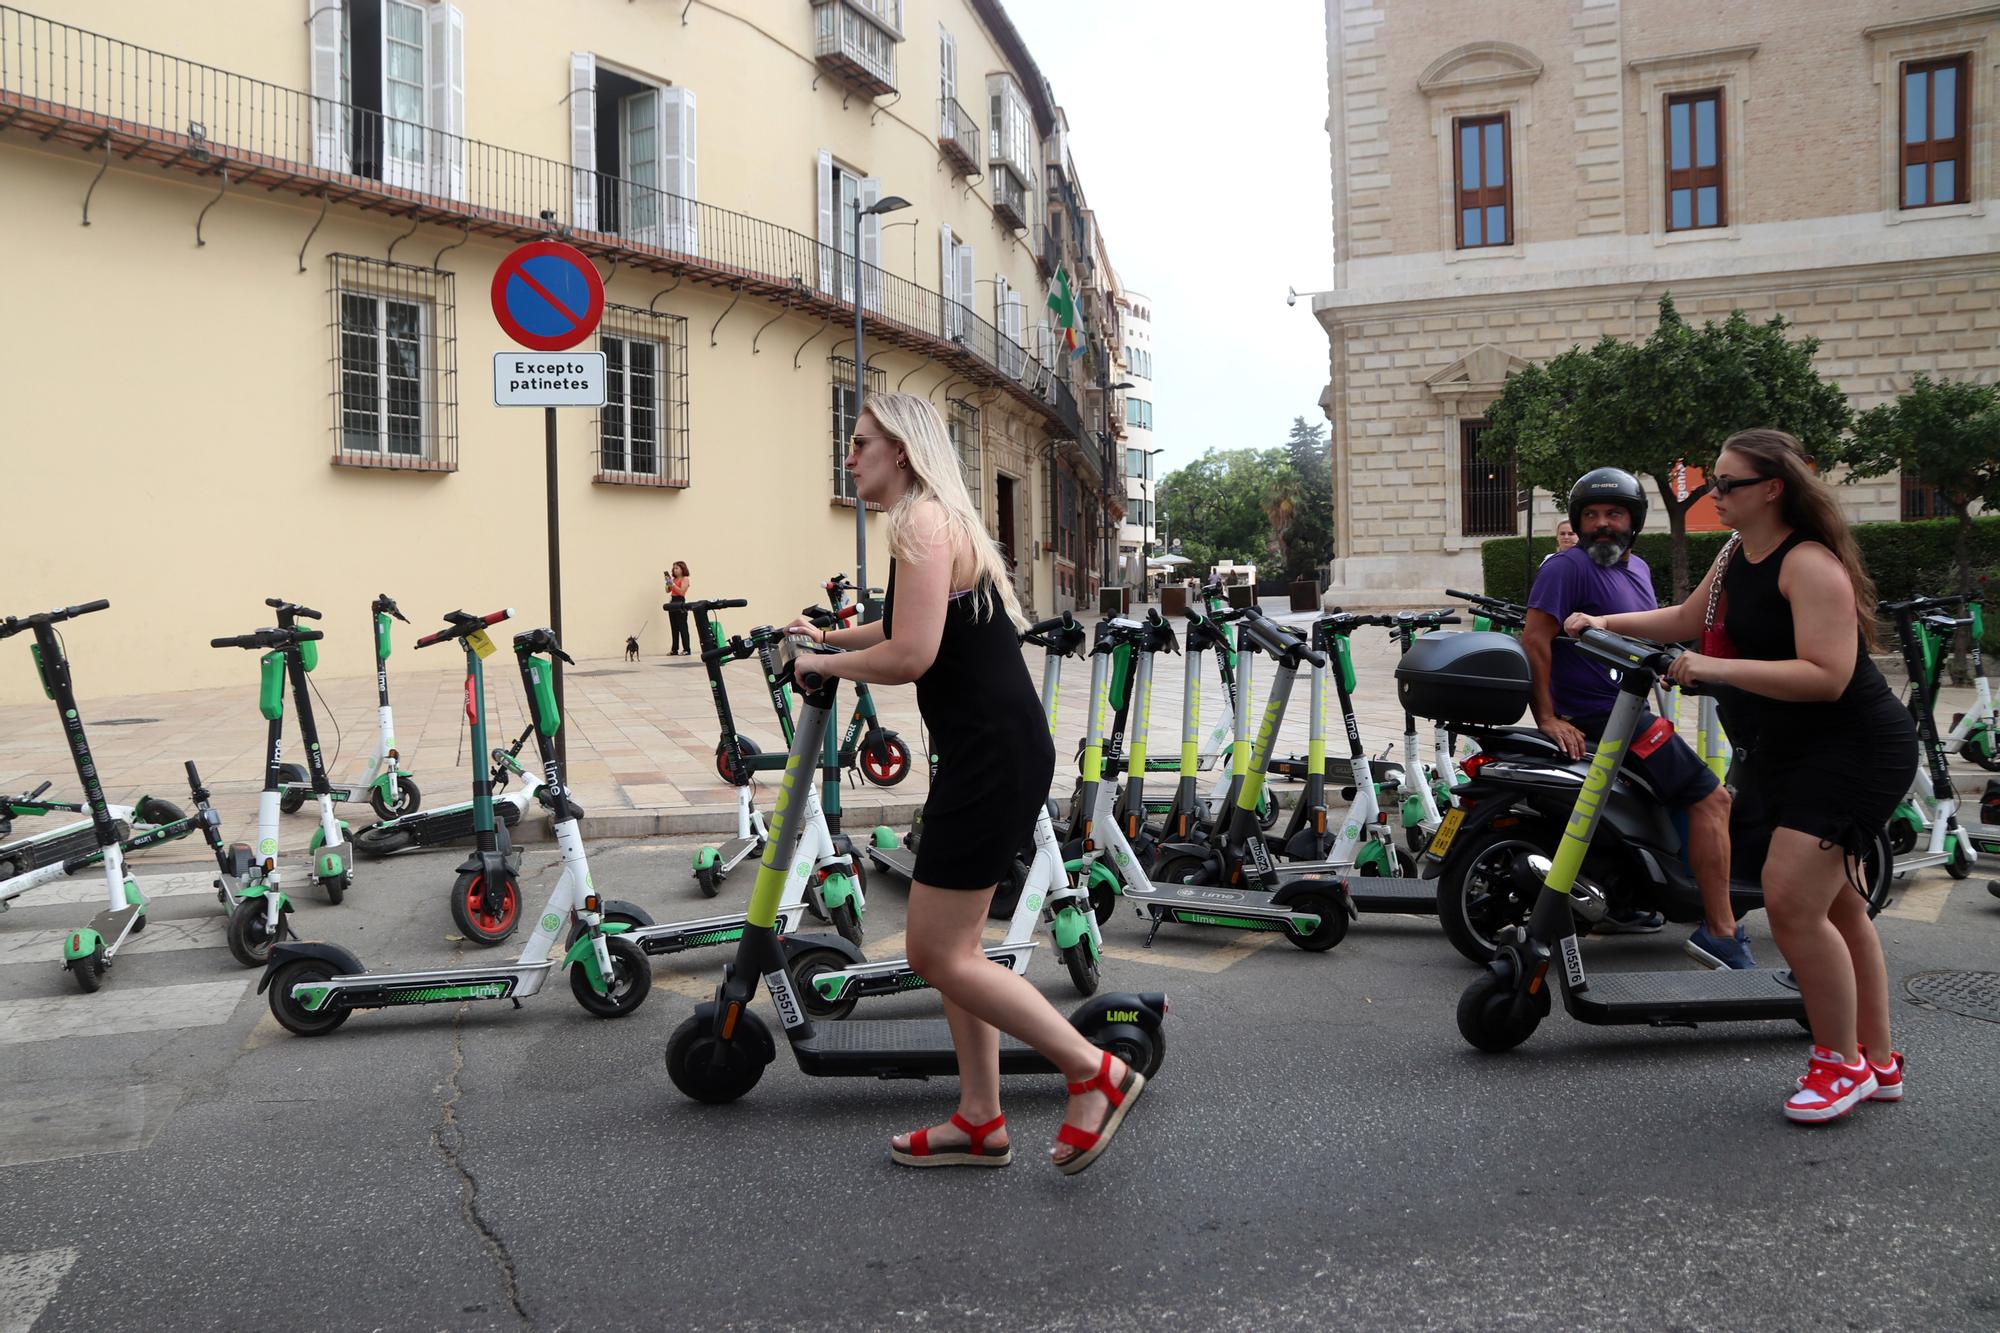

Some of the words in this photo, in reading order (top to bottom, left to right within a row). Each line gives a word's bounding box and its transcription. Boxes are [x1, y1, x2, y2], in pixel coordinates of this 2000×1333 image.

[515, 362, 584, 376] Excepto
[510, 378, 589, 392] patinetes
[377, 672, 386, 692] Lime
[772, 690, 783, 709] Lime
[845, 724, 857, 743] dott
[1345, 713, 1358, 740] Lime
[270, 739, 281, 769] Lime
[1109, 732, 1123, 760] Lime
[311, 751, 321, 769] Lime
[544, 760, 561, 796] Lime
[134, 835, 152, 846] Lime
[1202, 891, 1234, 899] Lime
[1192, 913, 1216, 924] Lime
[1566, 948, 1582, 983] 05576
[469, 983, 500, 998] Lime
[775, 985, 798, 1024] 05579
[1106, 1010, 1140, 1022] LINK
